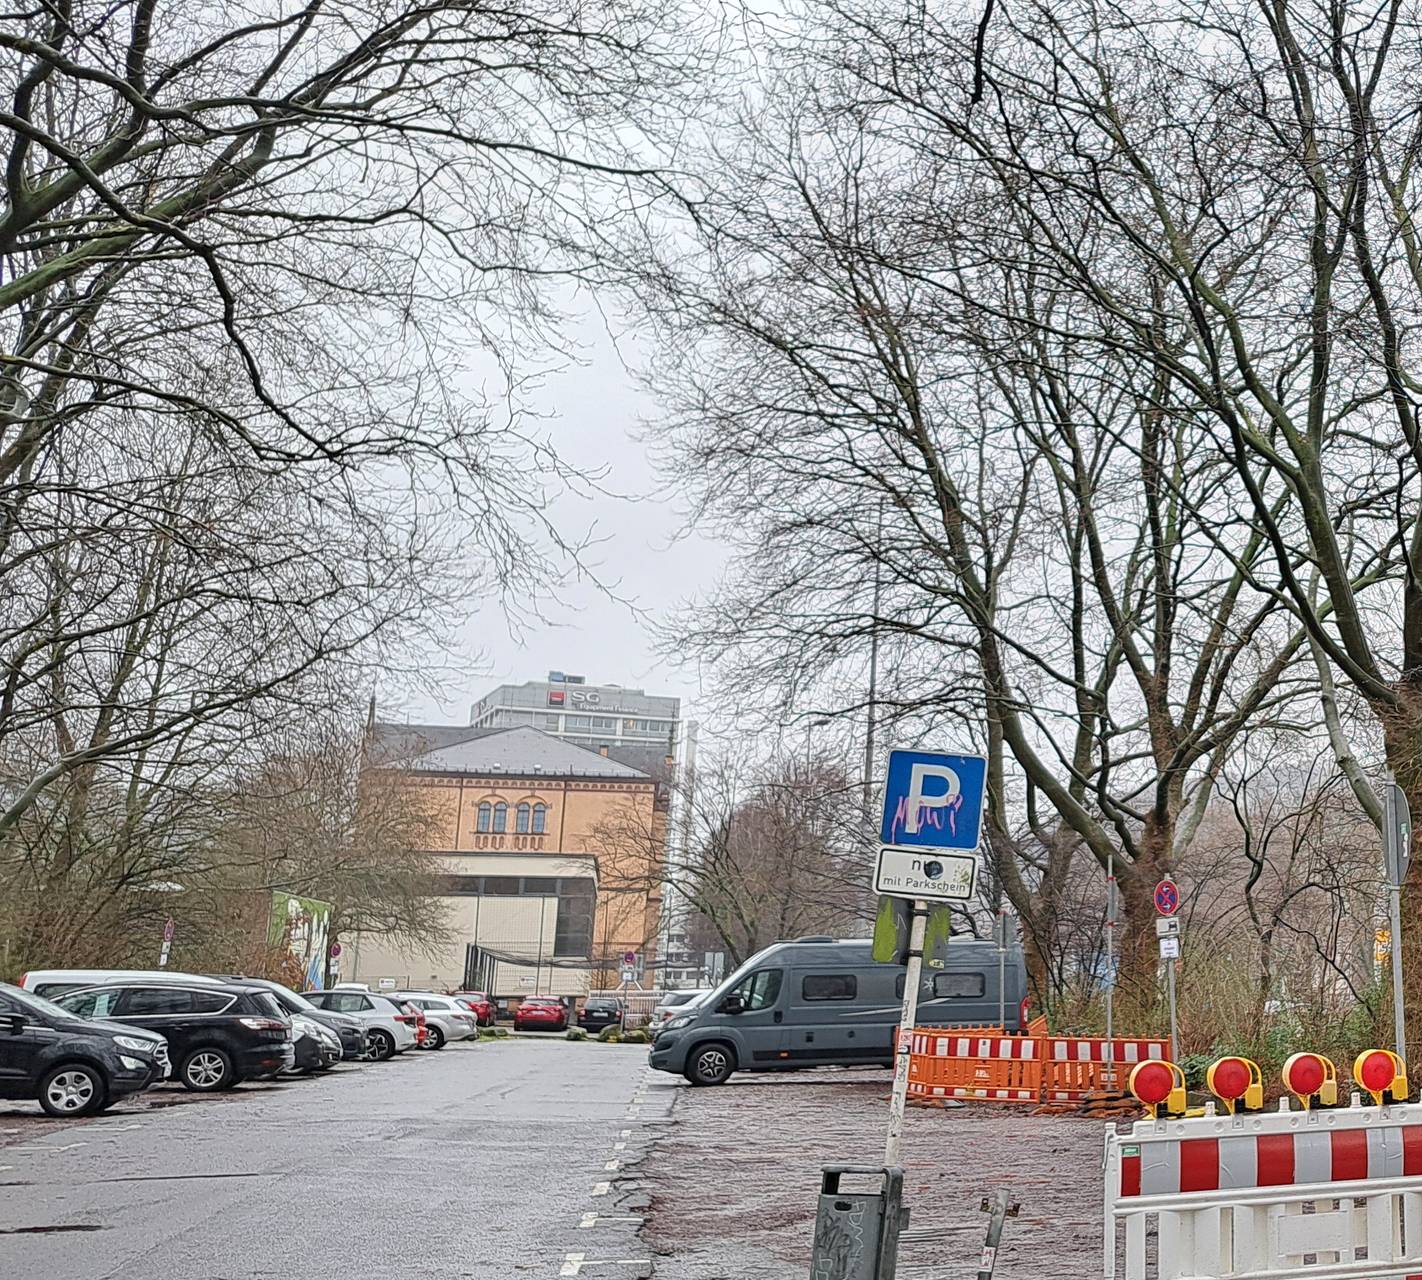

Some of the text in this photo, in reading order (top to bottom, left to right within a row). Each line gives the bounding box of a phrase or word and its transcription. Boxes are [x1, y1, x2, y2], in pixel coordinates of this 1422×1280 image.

[571, 690, 600, 704] SG
[905, 762, 961, 834] P
[883, 876, 966, 893] mit Parkschein
